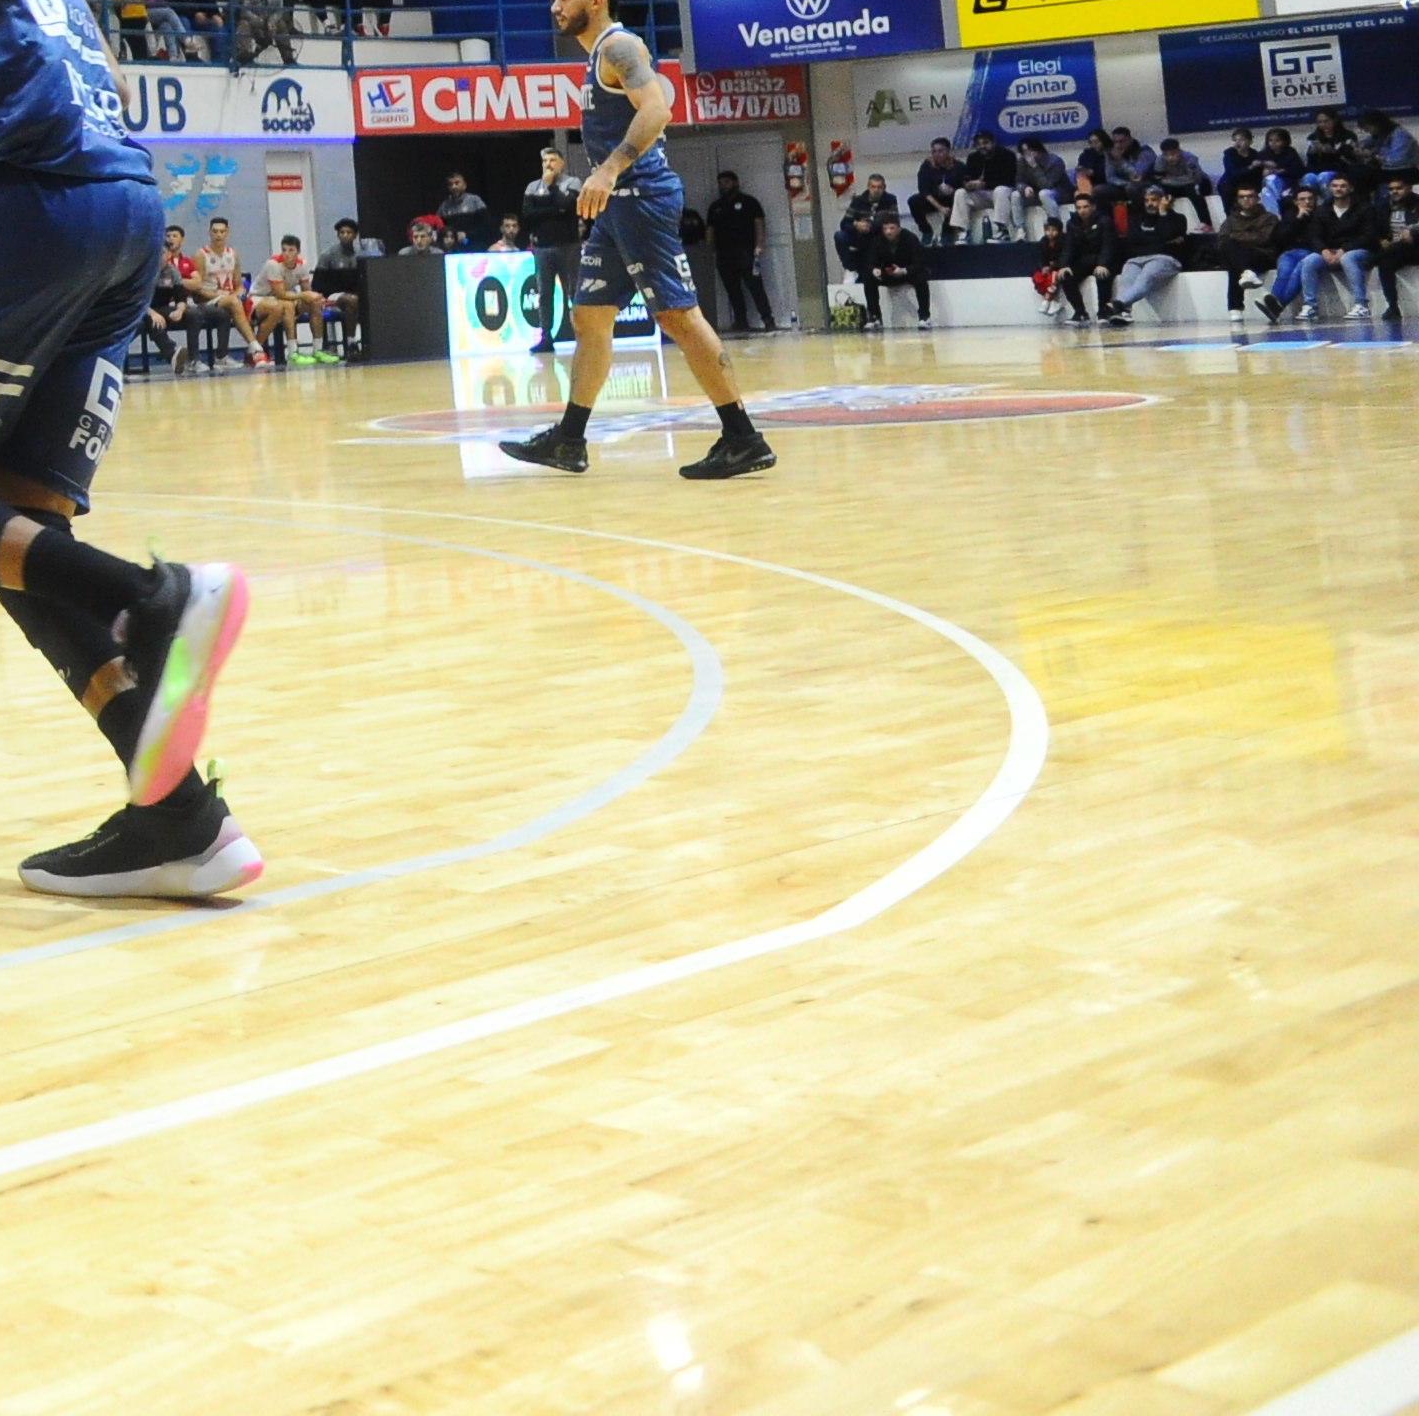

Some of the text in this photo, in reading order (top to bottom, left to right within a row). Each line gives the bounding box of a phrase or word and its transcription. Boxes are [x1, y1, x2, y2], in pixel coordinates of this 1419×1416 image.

[738, 8, 890, 48] Veneranda
[1015, 78, 1069, 98] pintar
[1272, 82, 1339, 98] FONTE
[261, 117, 313, 133] SOCIOS
[1005, 107, 1081, 129] Tersuave
